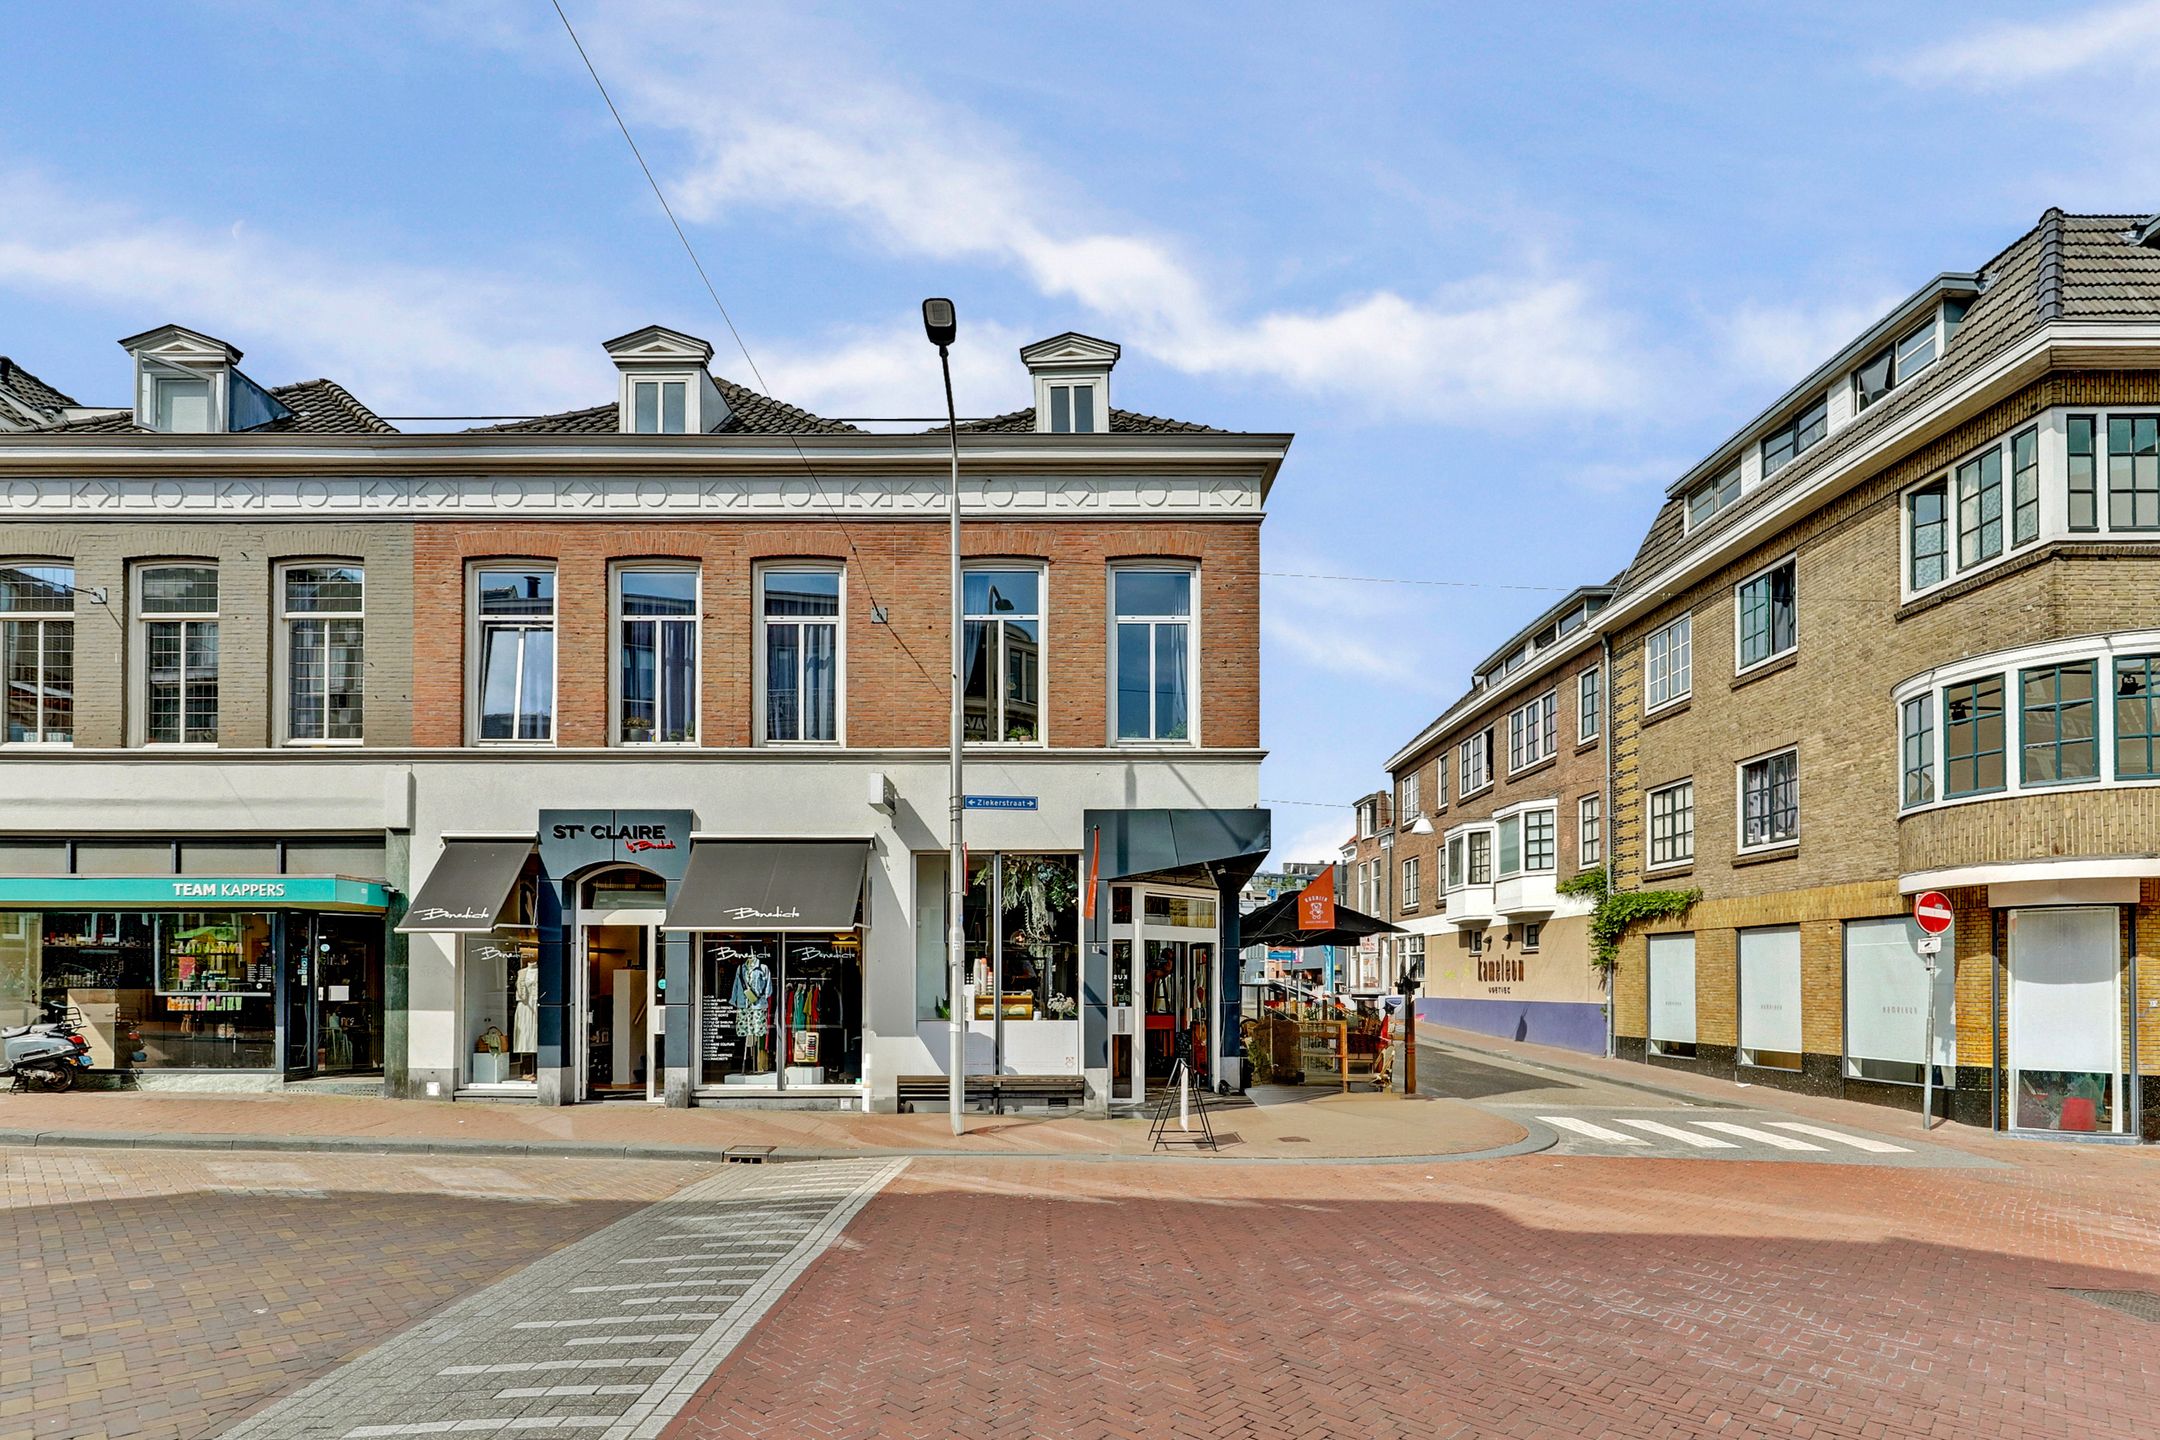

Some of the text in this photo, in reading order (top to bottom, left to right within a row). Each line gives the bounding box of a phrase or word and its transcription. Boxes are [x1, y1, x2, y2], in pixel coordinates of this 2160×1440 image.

[977, 799, 1026, 807] Ziekerstraat
[590, 824, 667, 840] CLAIRE
[172, 883, 286, 897] TEAM KAPPERS
[1477, 953, 1524, 983] kameleon
